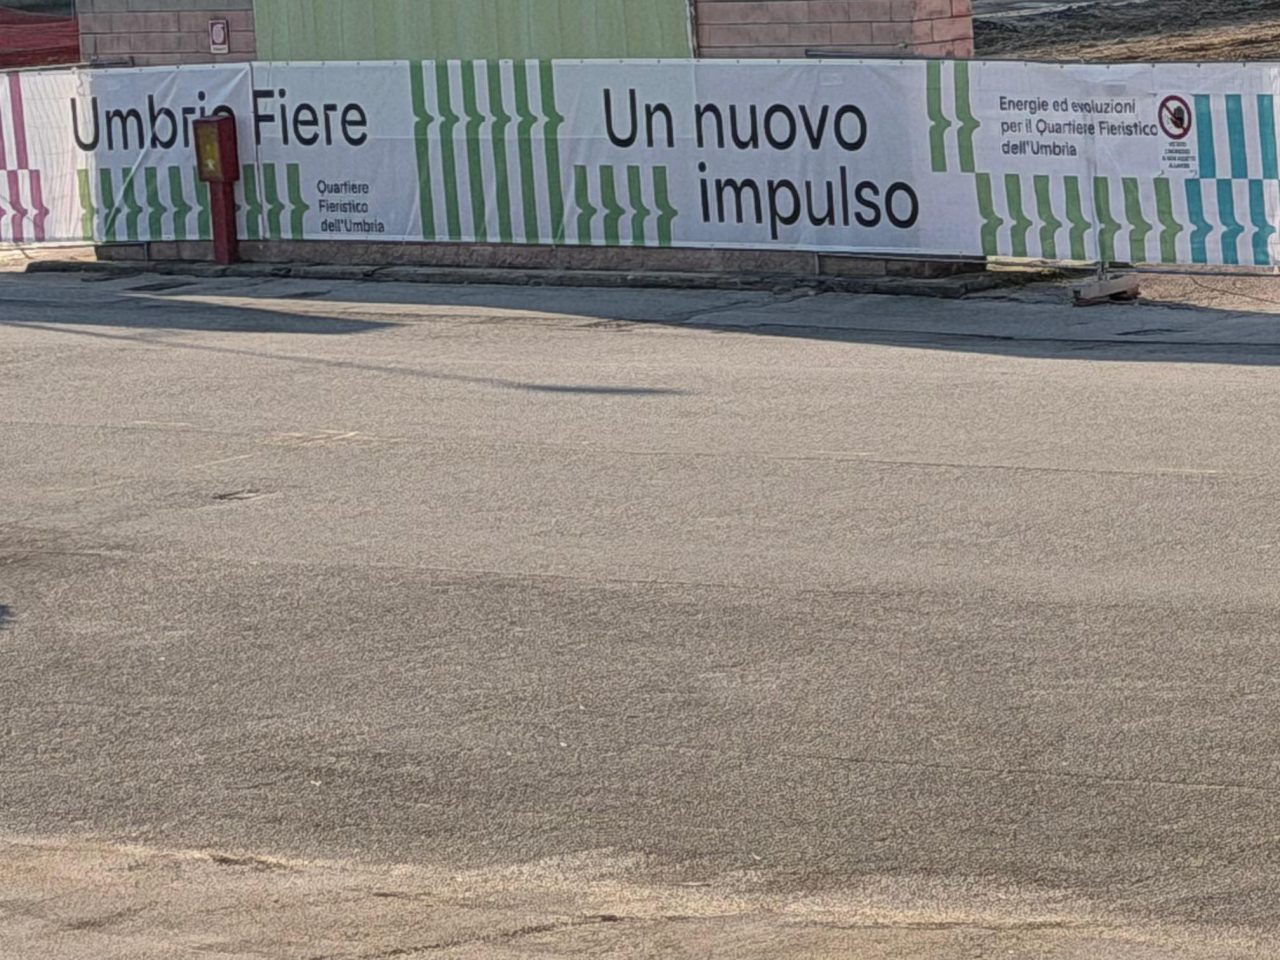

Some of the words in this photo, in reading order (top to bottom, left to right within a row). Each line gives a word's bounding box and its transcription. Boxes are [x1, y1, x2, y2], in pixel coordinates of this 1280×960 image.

[999, 95, 1050, 115] Energie
[1052, 98, 1069, 113] ed
[1071, 98, 1136, 114] evoluzioni
[70, 90, 237, 152] Umbri
[252, 88, 369, 147] Fiere
[603, 87, 675, 148] Un
[694, 102, 868, 151] nuovo
[1001, 120, 1021, 136] per
[1024, 118, 1033, 133] il
[1036, 118, 1096, 137] Quartiere
[1098, 120, 1159, 137] Fieristico
[1001, 140, 1078, 157] dell'Umbria
[316, 179, 370, 197] Quartiere
[318, 199, 369, 214] Fieristico
[697, 161, 920, 240] impulso
[320, 218, 385, 234] dell'Umbria
